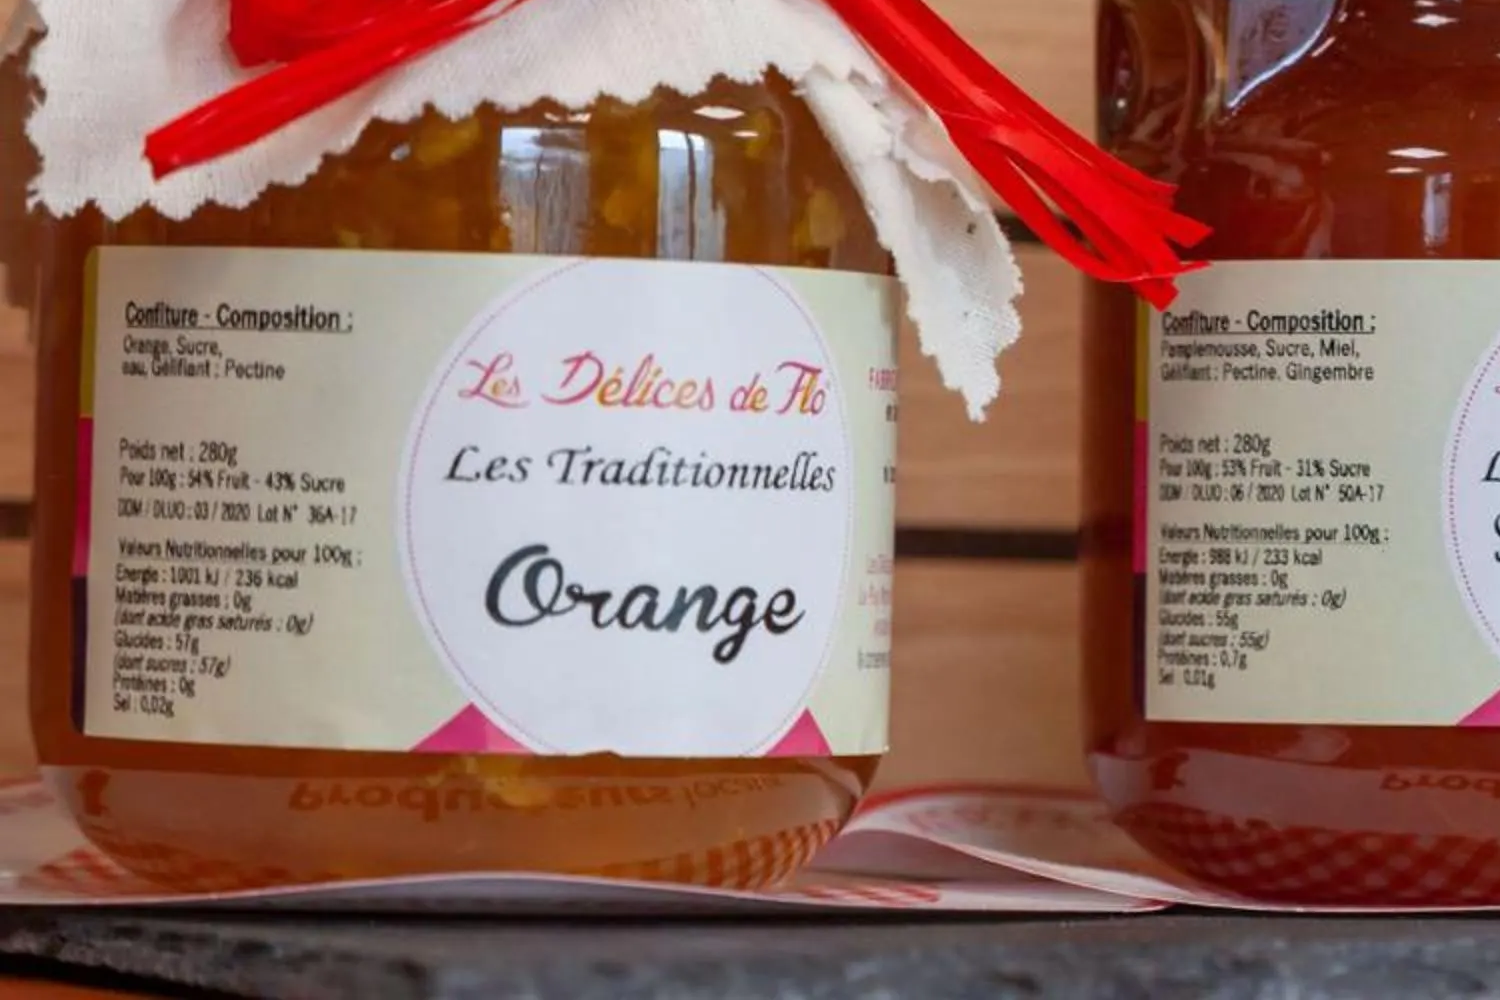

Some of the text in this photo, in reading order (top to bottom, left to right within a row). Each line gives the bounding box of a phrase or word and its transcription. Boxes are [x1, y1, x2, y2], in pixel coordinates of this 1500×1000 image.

[125, 301, 340, 331] Confiture Composition
[1161, 309, 1364, 334] Confiture Composition
[176, 334, 223, 358] Sucre,
[1265, 338, 1315, 359] Sucre,
[1319, 338, 1360, 358] Miel,
[225, 359, 285, 380] Pectine
[1286, 361, 1374, 384] Gingembre
[458, 353, 531, 410] Les
[540, 350, 715, 413] Délices
[729, 373, 768, 413] de
[119, 438, 238, 467] Poids net 280g
[1160, 433, 1272, 457] Poids net 280g
[443, 445, 533, 485] Les
[545, 445, 837, 492] Traditionnelles
[1159, 458, 1183, 477] Pour
[1250, 458, 1282, 477] Fruit
[1329, 459, 1371, 478] Sucre
[120, 467, 145, 486] Pour
[217, 471, 250, 490] Fruit
[265, 472, 295, 492] 43%
[300, 473, 345, 494] Sucre
[1291, 484, 1312, 501] Lot
[257, 504, 279, 524] Lot
[1160, 522, 1380, 544] Valeurs Nutritionnelles pour 100g
[118, 538, 352, 568] Valeurs Nutritionnelles pour 100g
[1293, 549, 1323, 566] kcal
[234, 569, 262, 588] 236
[267, 571, 298, 589] kcal
[1209, 572, 1259, 589] grasses
[1270, 569, 1289, 589] 0g
[169, 593, 220, 611] grasses
[233, 591, 252, 613] 0g
[484, 543, 806, 665] Orange
[1223, 592, 1252, 609] gras
[183, 613, 213, 632] gras
[216, 613, 272, 632] saturés
[175, 634, 199, 656] 57g
[113, 692, 131, 712] Sel
